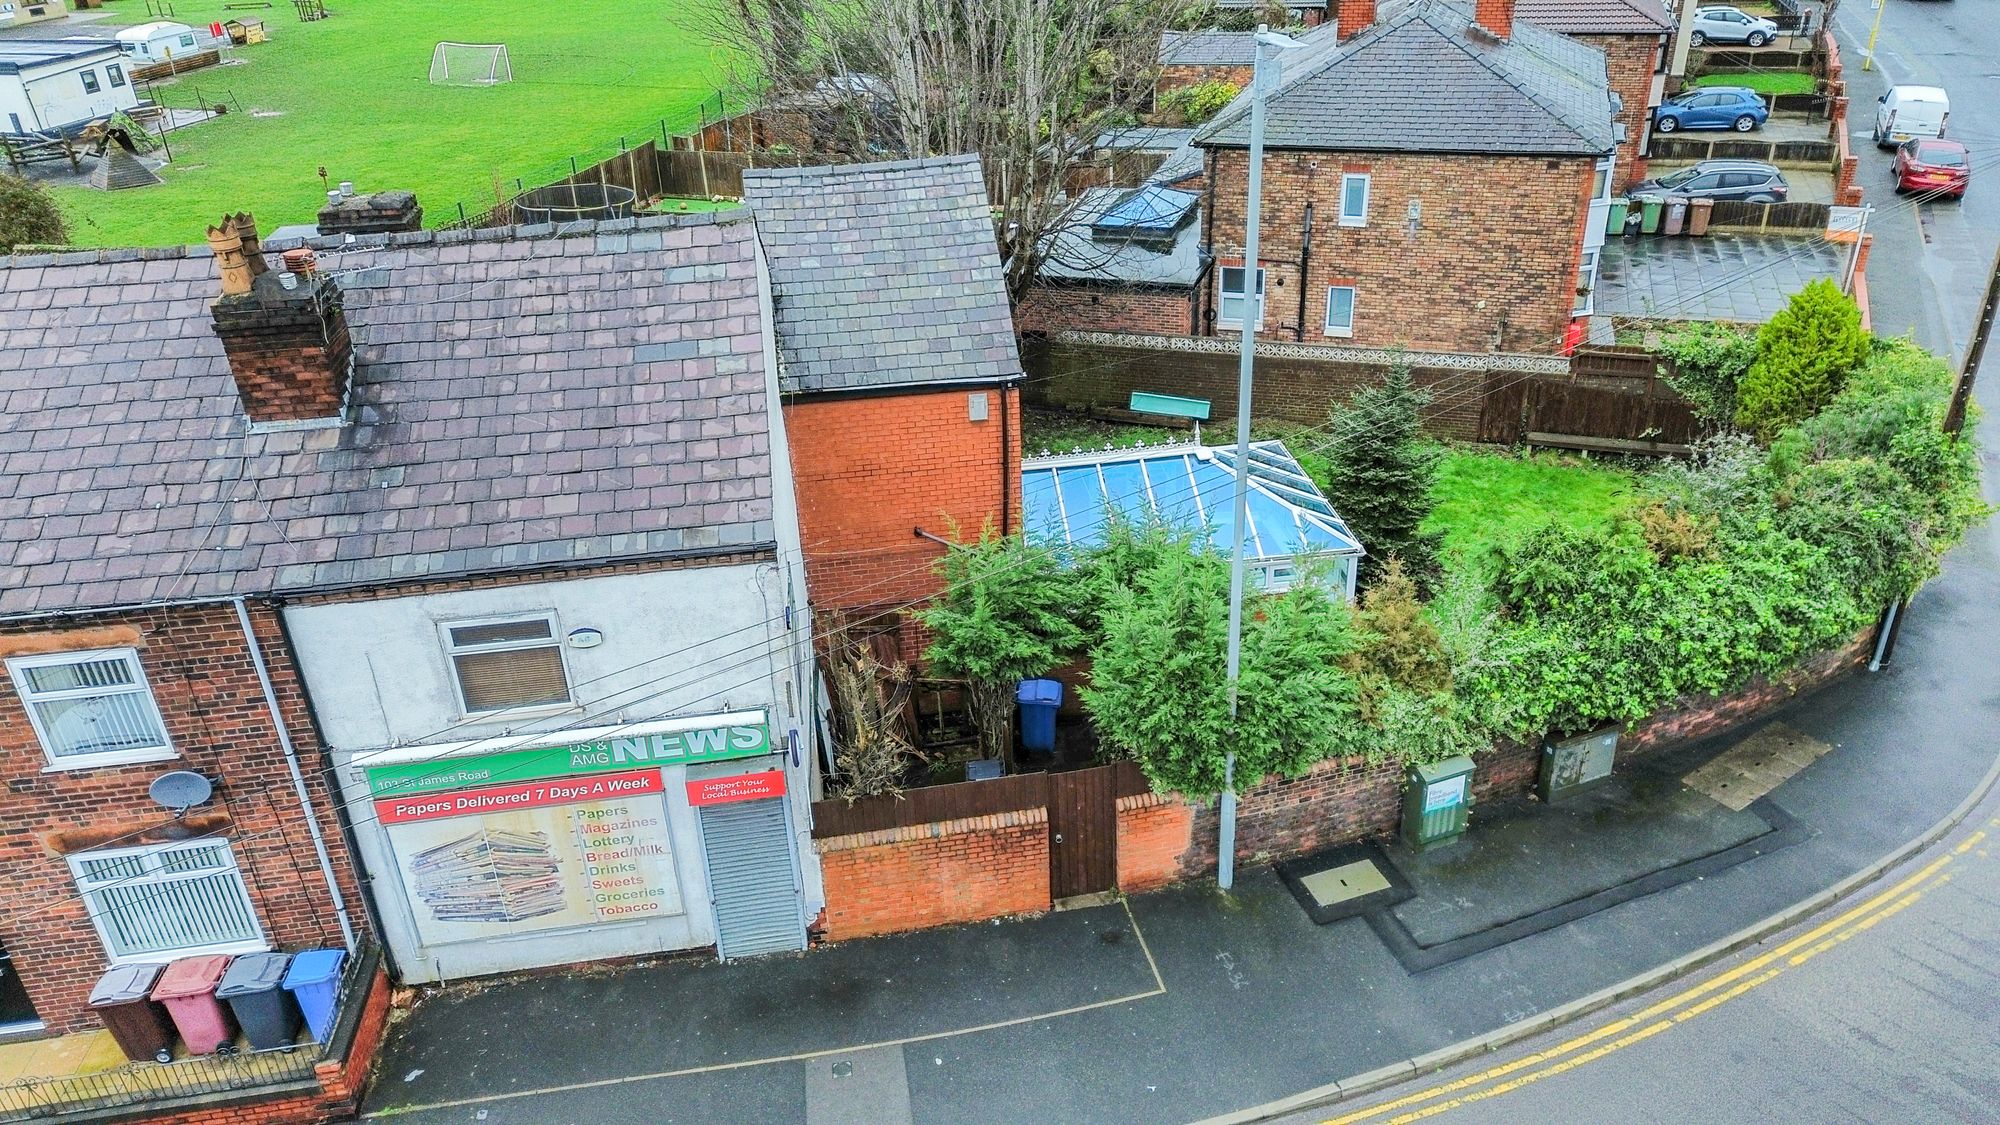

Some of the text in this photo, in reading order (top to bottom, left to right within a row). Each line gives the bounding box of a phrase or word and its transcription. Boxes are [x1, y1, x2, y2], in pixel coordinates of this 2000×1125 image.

[596, 741, 608, 751] &
[611, 725, 763, 762] NEWS
[572, 752, 609, 766] AMG
[418, 775, 456, 786] James
[457, 770, 489, 781] Road
[703, 779, 766, 792] Support Your
[396, 777, 650, 817] Papers Delivered 7 Days A Week
[702, 786, 770, 800] Local Business
[576, 806, 629, 820] Papers
[580, 817, 658, 834] Magazines
[582, 835, 635, 848] Lottery
[586, 844, 663, 862] Bread/Milk
[589, 863, 636, 876] Drinks
[592, 876, 644, 889] Sweets
[595, 887, 665, 902] Groceries
[597, 902, 658, 915] Tobacco
